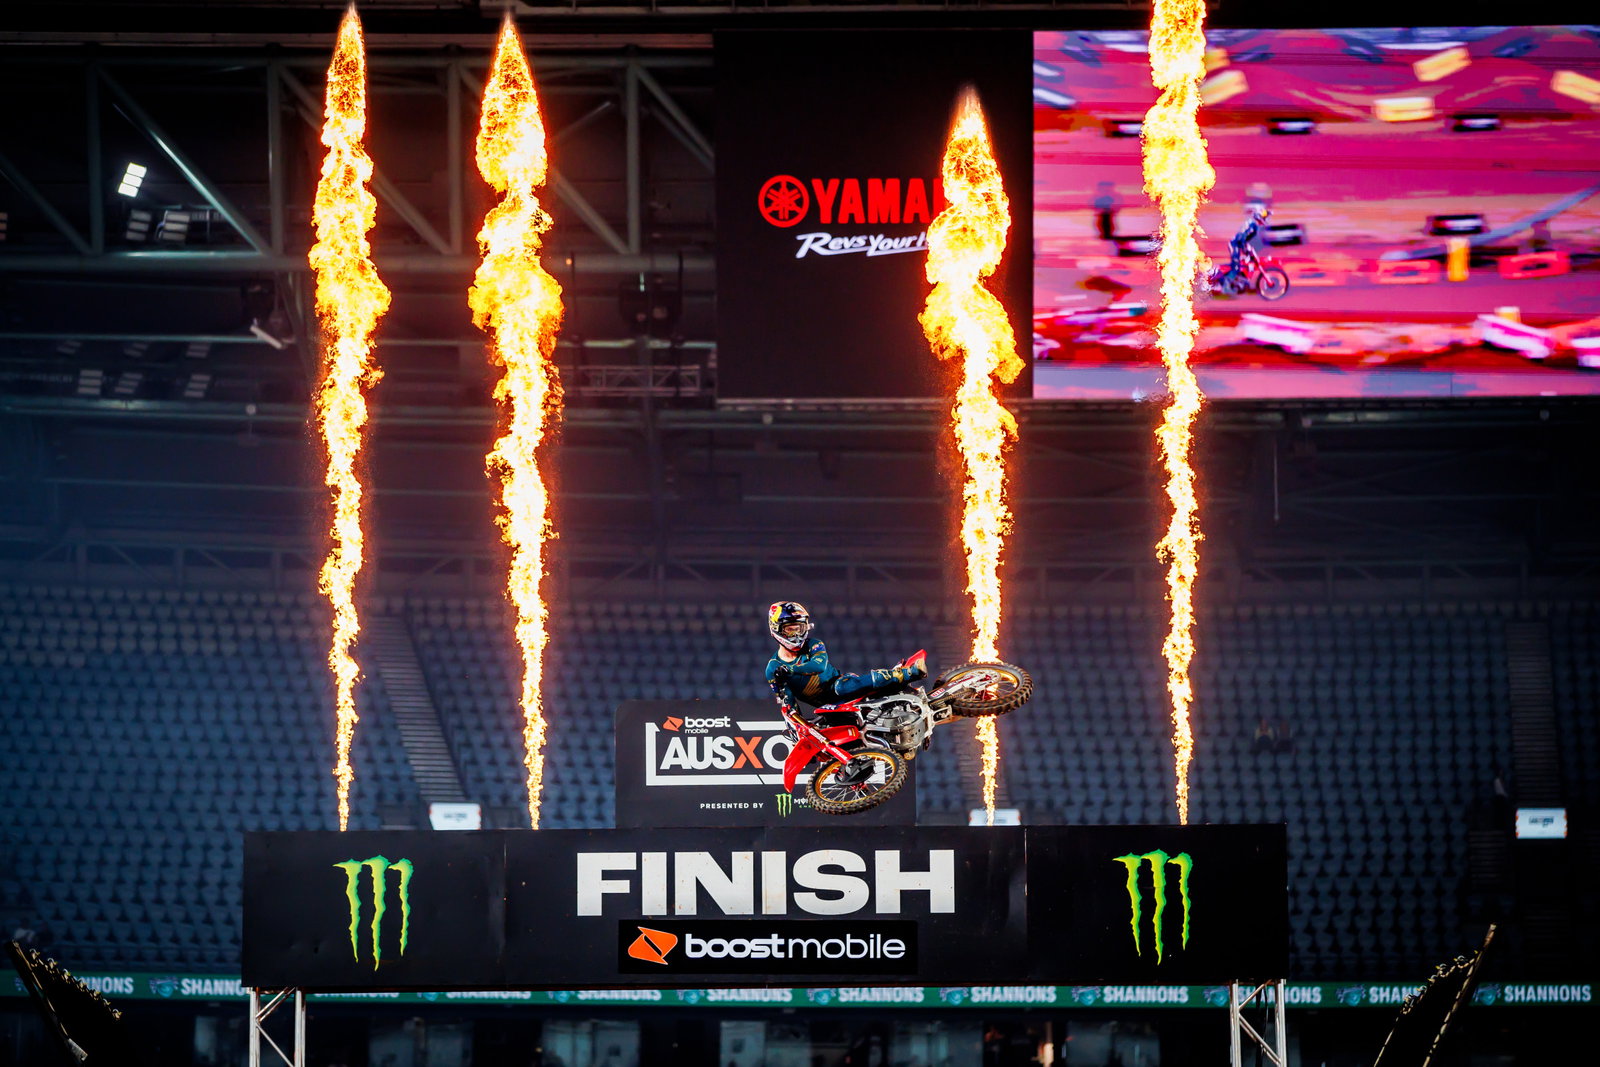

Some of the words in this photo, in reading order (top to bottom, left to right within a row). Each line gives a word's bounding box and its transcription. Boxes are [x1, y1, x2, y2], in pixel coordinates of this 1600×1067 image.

[796, 232, 868, 258] Revs
[866, 234, 918, 256] Your
[685, 716, 731, 728] boost
[577, 849, 955, 916] FINISH
[181, 978, 246, 996] SHANNO
[838, 987, 924, 1003] SHANNONS
[970, 986, 1057, 1003] SHANNONS
[1103, 986, 1189, 1003] SHANNONS
[1504, 985, 1591, 1002] SHANNONS
